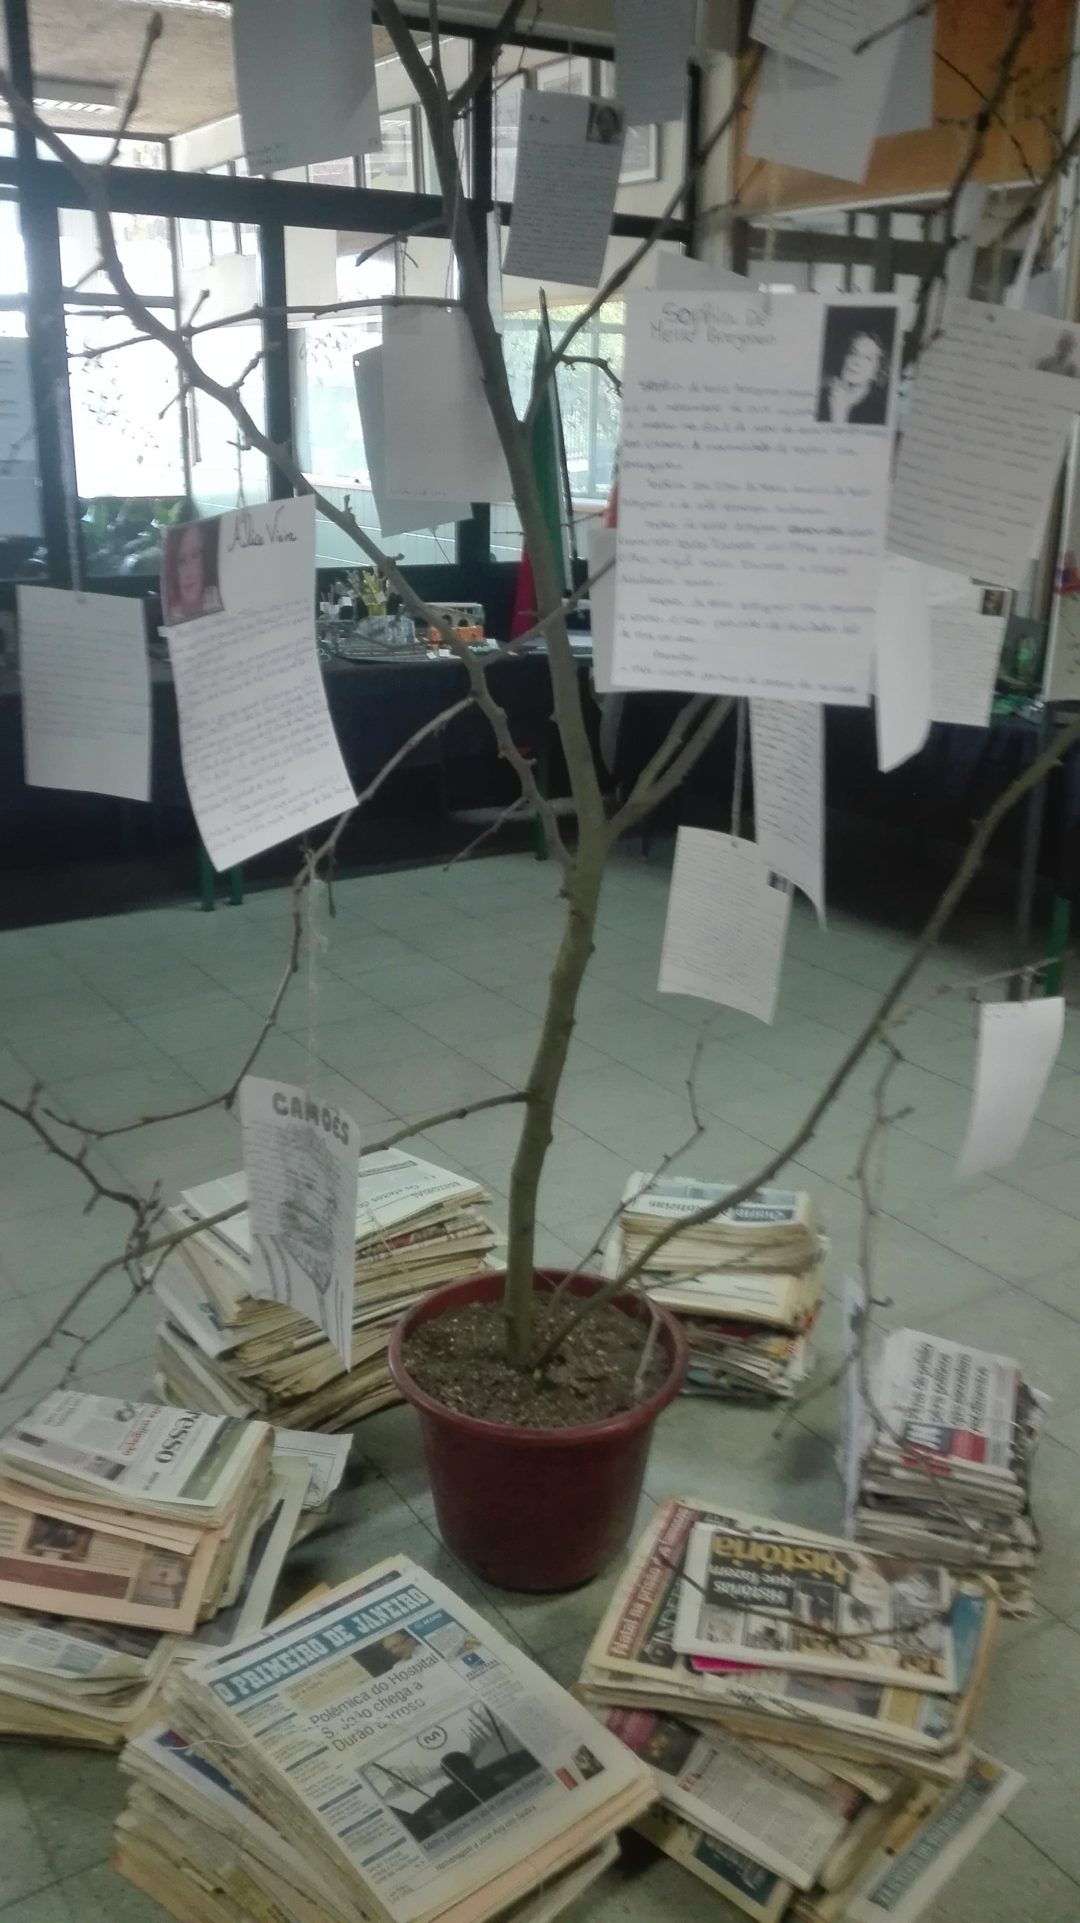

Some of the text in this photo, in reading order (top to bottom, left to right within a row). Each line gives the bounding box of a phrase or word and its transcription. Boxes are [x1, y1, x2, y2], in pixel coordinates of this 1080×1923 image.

[155, 1410, 204, 1464] resso
[714, 1535, 847, 1586] história
[213, 1682, 237, 1703] O
[229, 1638, 330, 1696] PRIMEIRO
[322, 1624, 356, 1648] DE
[351, 1587, 430, 1634] JANEIRO
[309, 1690, 371, 1725] Polémica
[371, 1681, 390, 1696] do
[388, 1654, 440, 1685] Hospital
[373, 1687, 413, 1712] chega
[332, 1725, 375, 1752] Durão
